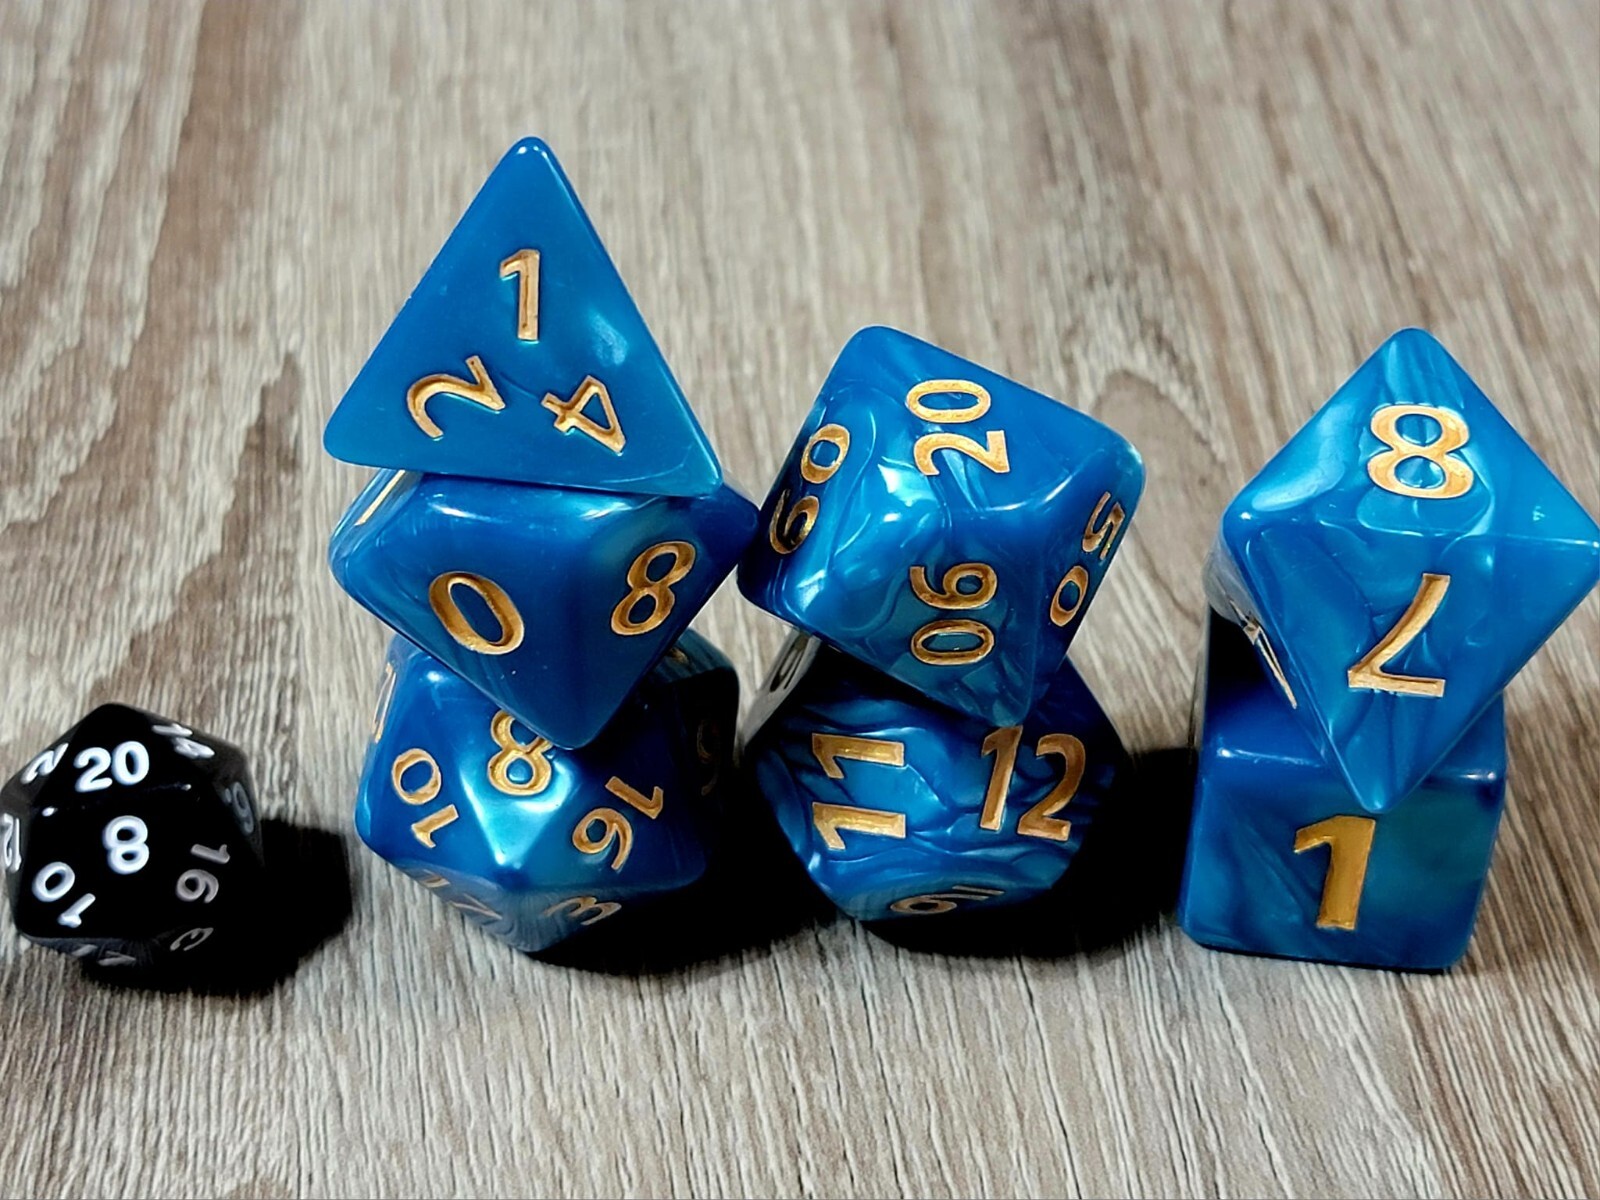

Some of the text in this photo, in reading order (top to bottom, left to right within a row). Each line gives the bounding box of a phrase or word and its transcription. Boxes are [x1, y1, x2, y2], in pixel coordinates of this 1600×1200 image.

[500, 249, 540, 341] 1
[407, 356, 505, 438] 2
[541, 375, 626, 454] 4
[906, 379, 1010, 475] 20
[1367, 404, 1474, 499] 8
[610, 541, 696, 635] 8
[1050, 491, 1125, 627] 50
[428, 571, 524, 655] 0
[1348, 573, 1450, 698] 7
[73, 740, 149, 792] 20
[391, 748, 460, 848] 10
[487, 710, 554, 796] 8
[812, 732, 906, 850] 11
[980, 725, 1086, 841] 12
[102, 814, 150, 875] 8
[572, 775, 664, 870] 16
[31, 861, 96, 928] 10
[175, 844, 231, 903] 16
[1293, 815, 1376, 931] 1
